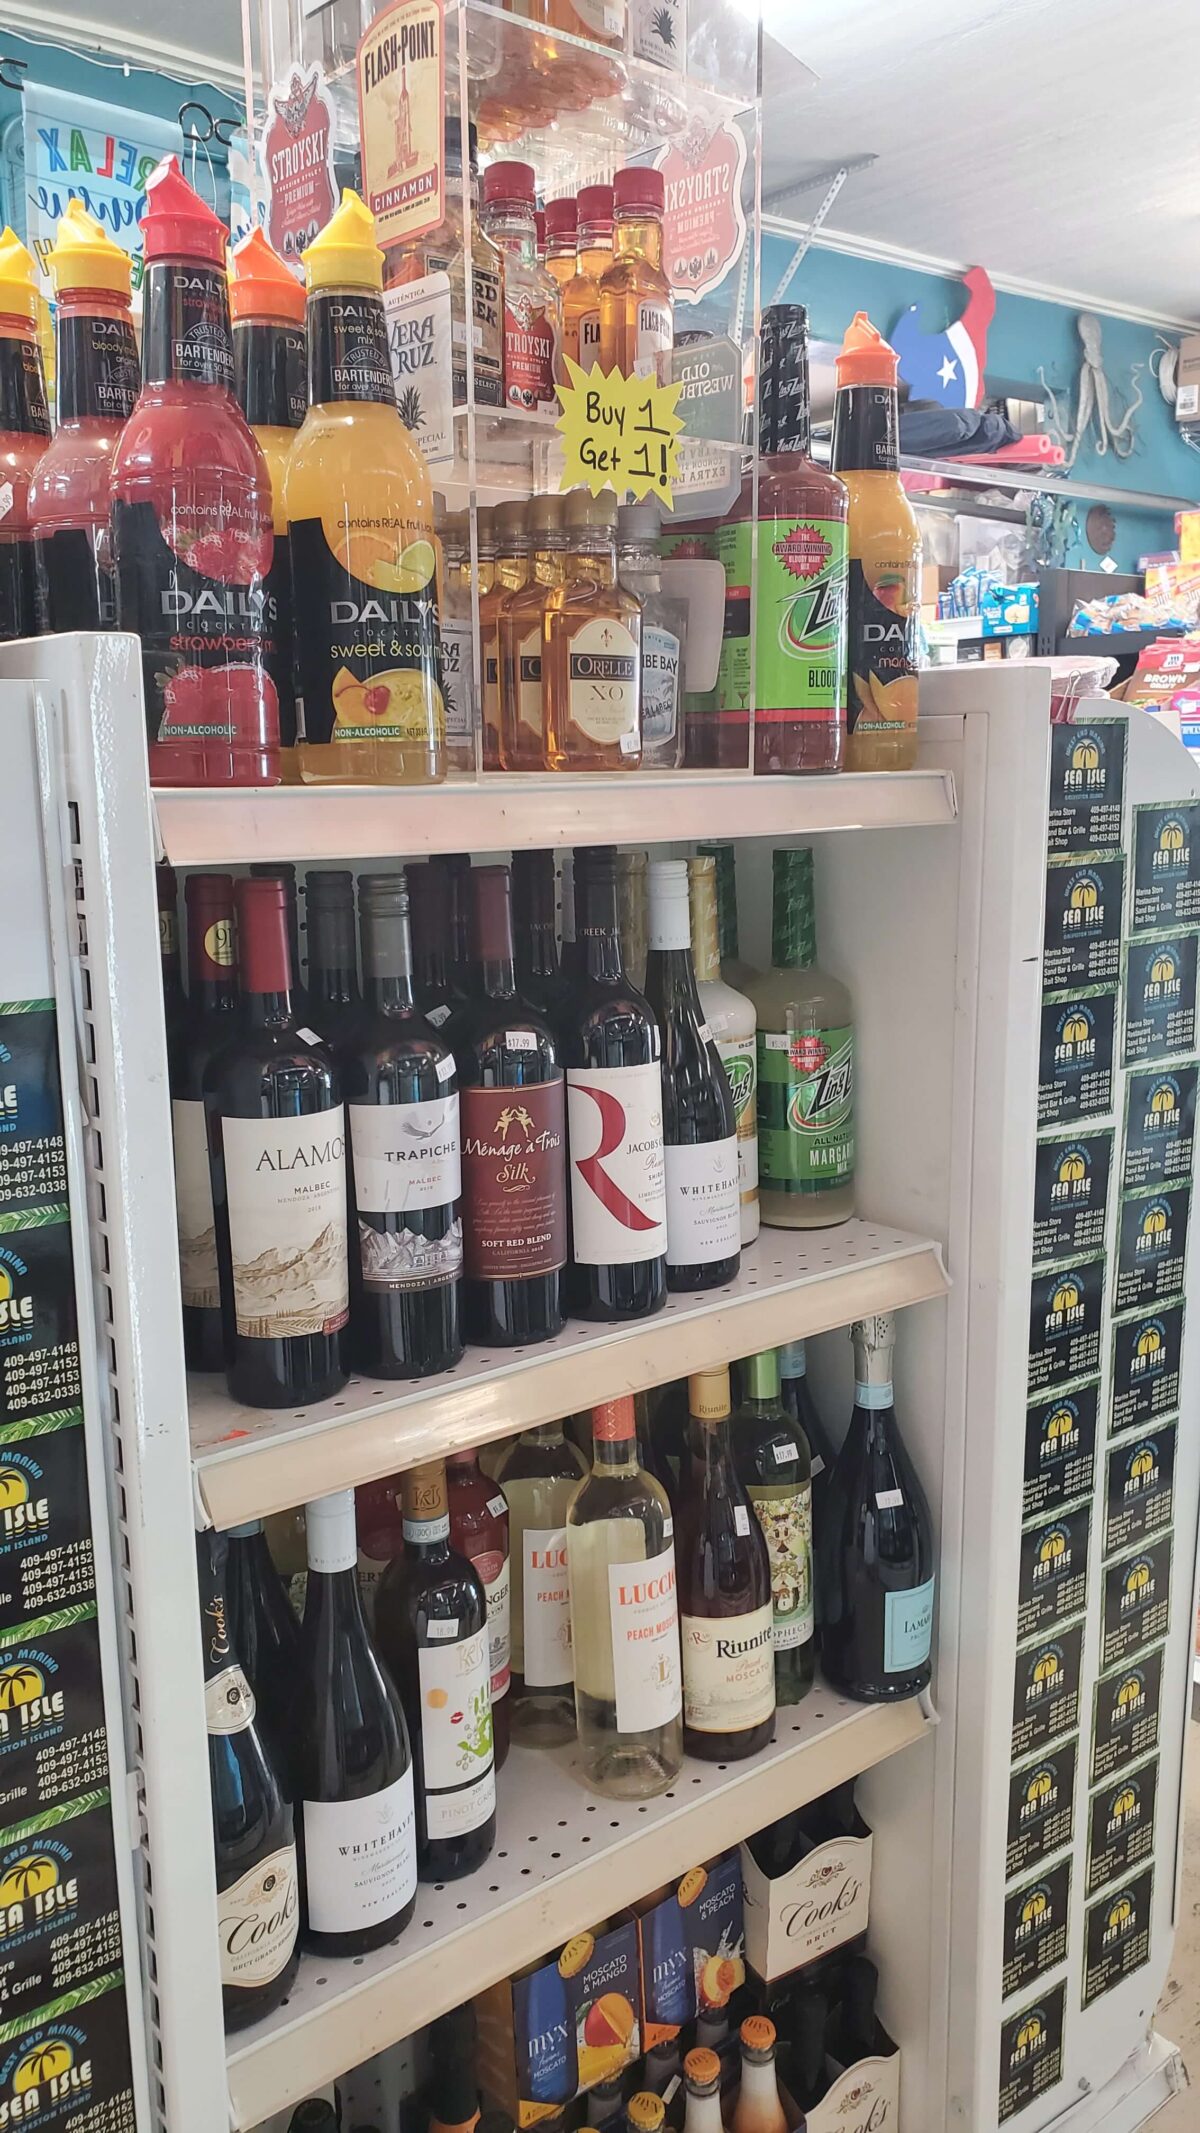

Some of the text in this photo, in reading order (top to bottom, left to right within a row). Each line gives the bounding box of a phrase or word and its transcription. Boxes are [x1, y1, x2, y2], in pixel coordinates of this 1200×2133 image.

[272, 129, 325, 184] STROYSKI
[284, 184, 315, 207] PREMIUM
[374, 174, 433, 212] CINNAMON
[334, 324, 366, 334] sweet
[357, 335, 374, 345] mix
[175, 343, 234, 369] BARTENDER
[338, 382, 350, 391] for
[586, 391, 670, 436] Buy 1
[580, 438, 621, 471] Get
[171, 505, 217, 516] contains
[337, 518, 405, 529] contains REAL
[160, 590, 278, 623] DAILY'S
[330, 599, 440, 629] DAILY'S
[330, 640, 386, 659] sweet
[390, 640, 403, 654] &
[577, 655, 632, 679] ORELLE
[659, 657, 678, 675] BAY
[1144, 673, 1187, 684] BROWN
[590, 685, 624, 701] XO
[163, 724, 237, 735] NON-ALCOHOLIC
[334, 727, 400, 737] NON-ALCOHOLIC
[1064, 768, 1106, 786] SEA ISLE
[1153, 847, 1190, 866] SEA ISLE
[1063, 906, 1104, 925] SEA ISLE
[1144, 978, 1181, 998] SEA ISLE
[507, 1037, 530, 1048] $17.99
[1055, 1038, 1096, 1060] SEA ISLE
[384, 1141, 456, 1163] TRAPICHE
[461, 1137, 522, 1161] Ménage
[536, 1130, 560, 1152] Trois
[814, 1137, 831, 1146] ALL
[409, 1175, 442, 1186] MALBEC
[496, 1161, 536, 1184] Silk
[294, 1181, 331, 1195] MALBEC
[482, 1233, 552, 1248] SOFT RED BLEND
[1136, 1228, 1172, 1250] SEA ISLE
[389, 1280, 426, 1289] MENDOZA
[4, 1341, 78, 1368] 409-497-4148
[5, 1355, 79, 1382] 409-497-4152
[6, 1370, 80, 1396] 409-497-4153
[7, 1383, 81, 1410] 409-632-0338
[4, 1498, 49, 1530] ISLE
[15, 1533, 49, 1550] ISLAND
[20, 1538, 92, 1569] 409-497-4148
[21, 1552, 93, 1583] 409-497-4152
[22, 1565, 94, 1596] 409-497-4153
[23, 1578, 95, 1610] 409-632-0338
[537, 1591, 564, 1602] PEACH
[627, 1627, 654, 1641] PEACH
[716, 1626, 772, 1658] Riunite
[726, 1662, 769, 1682] MOSCATO
[20, 1691, 65, 1724] ISLE
[30, 1725, 63, 1744] ISLAND
[36, 1727, 106, 1761] 409-497-4148
[36, 1740, 107, 1775] 409-497-4152
[38, 1752, 108, 1788] 409-497-4153
[39, 1765, 109, 1801] 409-632-0338
[1020, 1789, 1057, 1820] SEA ISLE
[3, 1844, 28, 1865] END
[354, 1868, 395, 1888] SAUVIGNON
[35, 1878, 78, 1915] ISLE
[699, 1883, 736, 1913] MOSCATO
[701, 1893, 735, 1921] & PEACH
[780, 1875, 864, 1938] Cook's
[44, 1912, 77, 1933] ISLAND
[50, 1910, 118, 1950] 409-497-4148
[50, 1923, 119, 1963] 409-497-4152
[806, 1926, 837, 1947] BRUT
[52, 1936, 121, 1976] 409-497-4153
[53, 1948, 121, 1988] 409-632-0338
[653, 1946, 687, 1983] myx
[583, 1955, 627, 1984] MOSCATO
[583, 1964, 627, 1994] & MANGO
[12, 1974, 42, 1996] Grille
[658, 1979, 686, 2003] MOSCATO
[528, 2020, 569, 2058] myx
[1010, 2031, 1047, 2067] SEA ISLE
[533, 2056, 567, 2080] MOSCATO
[0, 2088, 40, 2124] SEA
[50, 2060, 92, 2101] ISLE
[65, 2088, 132, 2130] 409-497-4148
